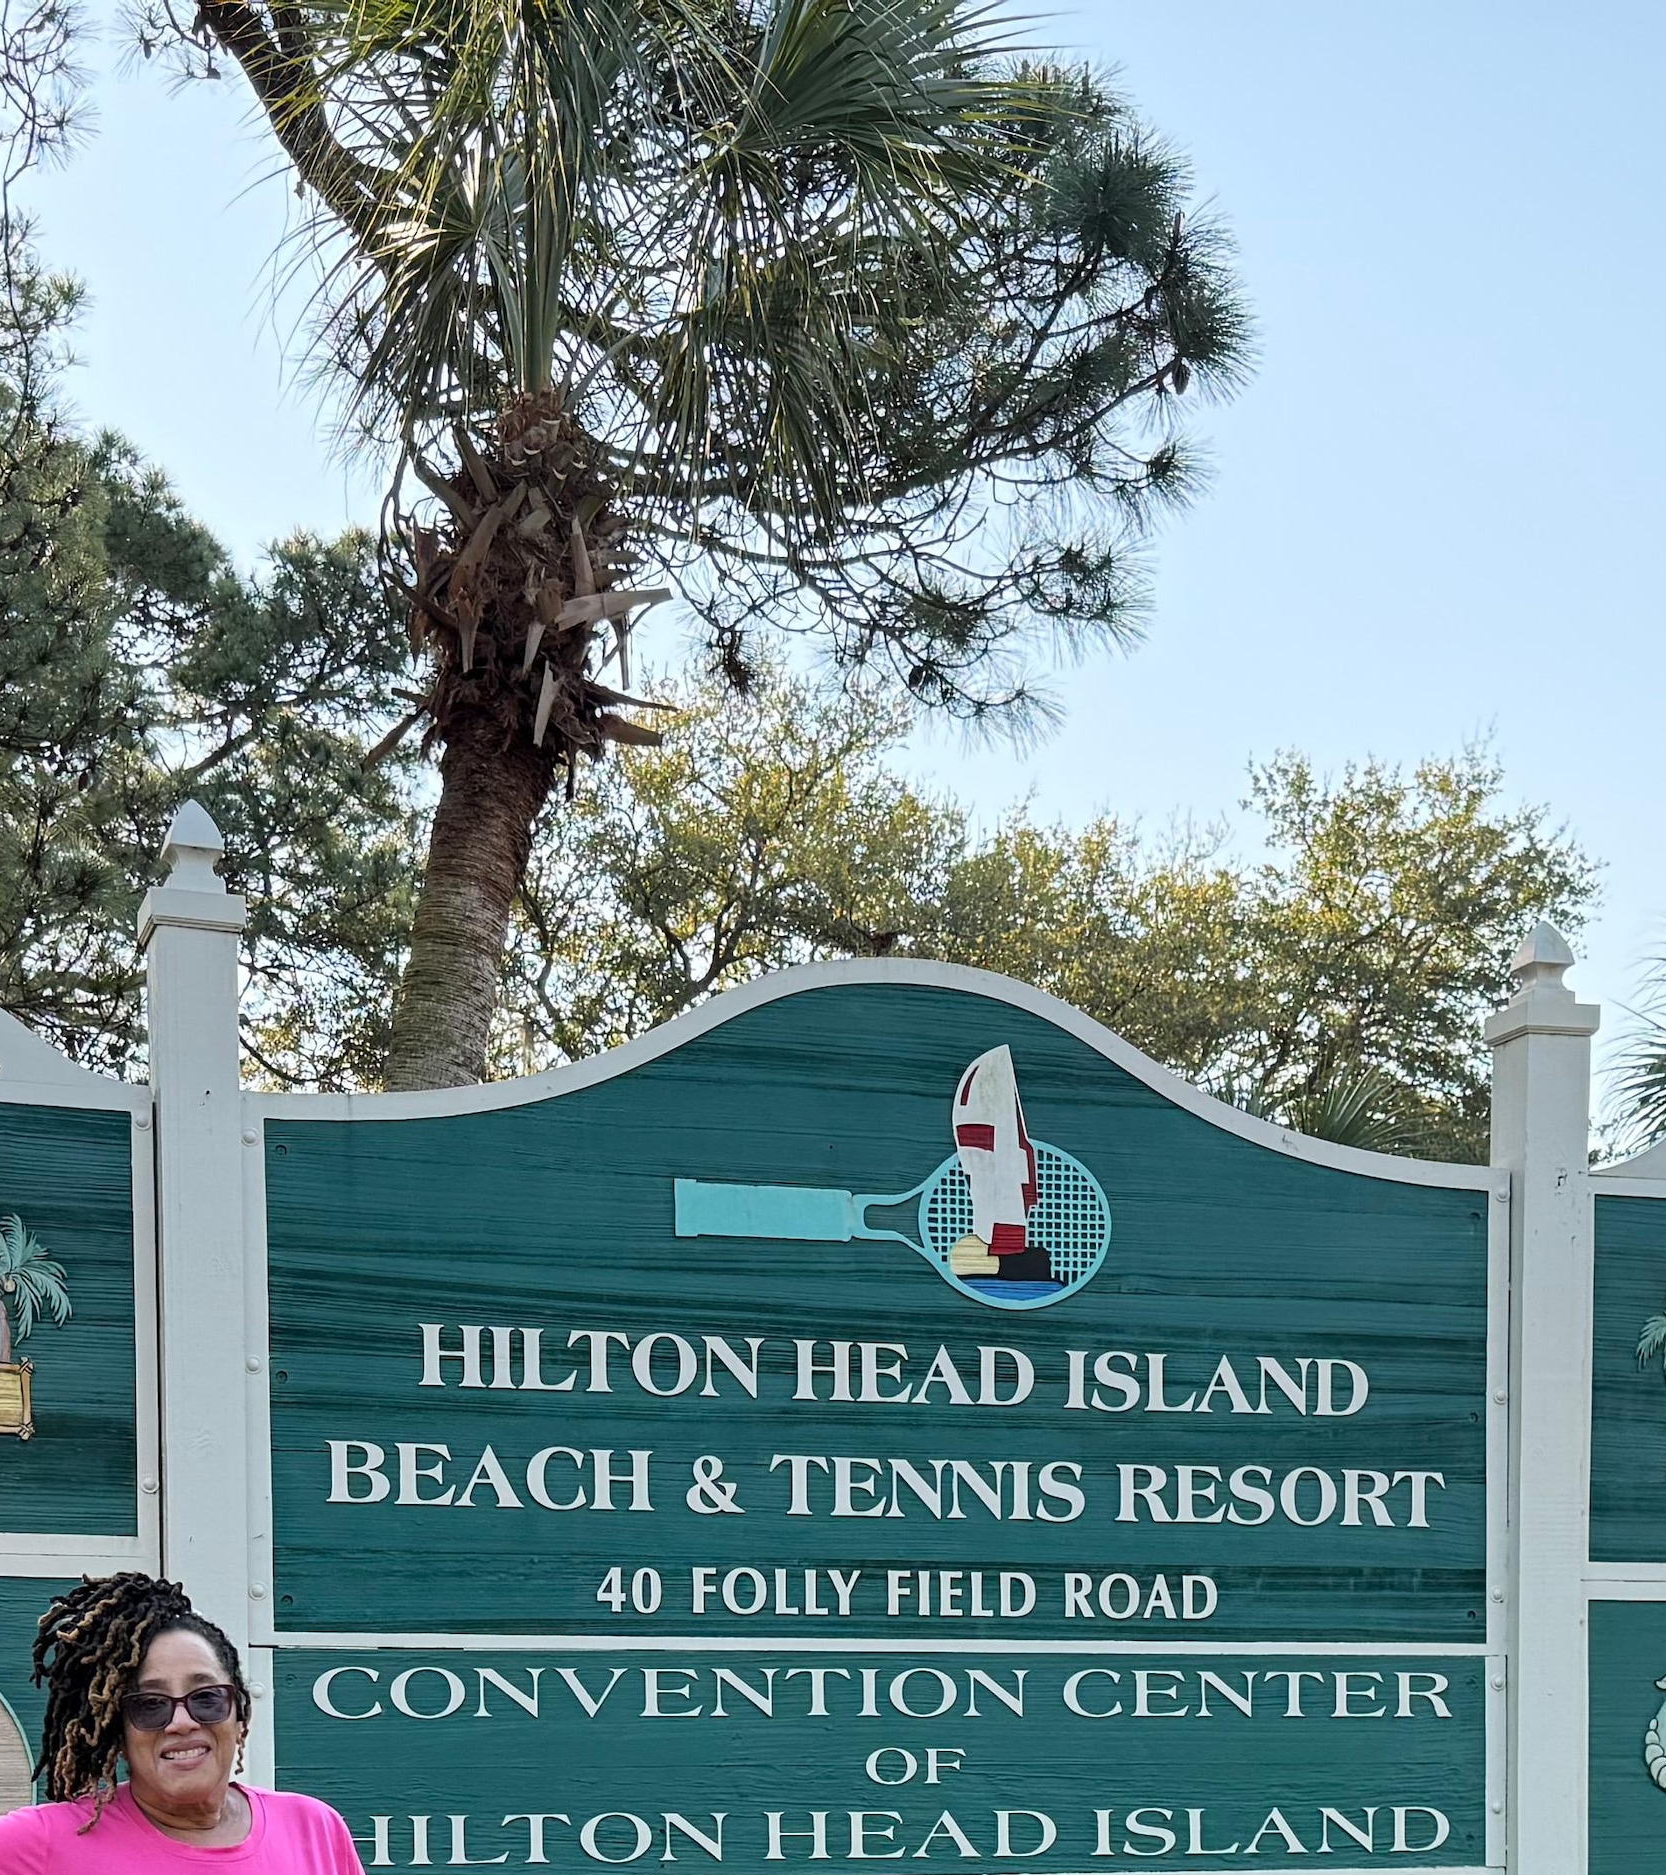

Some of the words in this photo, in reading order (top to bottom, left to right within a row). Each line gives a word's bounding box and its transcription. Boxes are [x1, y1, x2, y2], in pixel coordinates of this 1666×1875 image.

[419, 1324, 764, 1399] HILTON
[793, 1339, 1035, 1406] HEAD
[1064, 1350, 1369, 1416] ISLAND
[326, 1440, 654, 1511] BEACH
[685, 1455, 745, 1514] &
[770, 1455, 1084, 1522] TENNIS
[1116, 1464, 1446, 1528] RESORT
[597, 1567, 662, 1614] 40
[693, 1567, 861, 1616] FOLLY
[887, 1570, 1036, 1617] FIELD
[1064, 1572, 1218, 1619] ROAD
[312, 1667, 1028, 1719] CONVENTION
[1063, 1669, 1451, 1718] CENTER
[865, 1747, 966, 1785] OF
[764, 1810, 1057, 1860] HEAD
[1092, 1806, 1450, 1856] ISLAND
